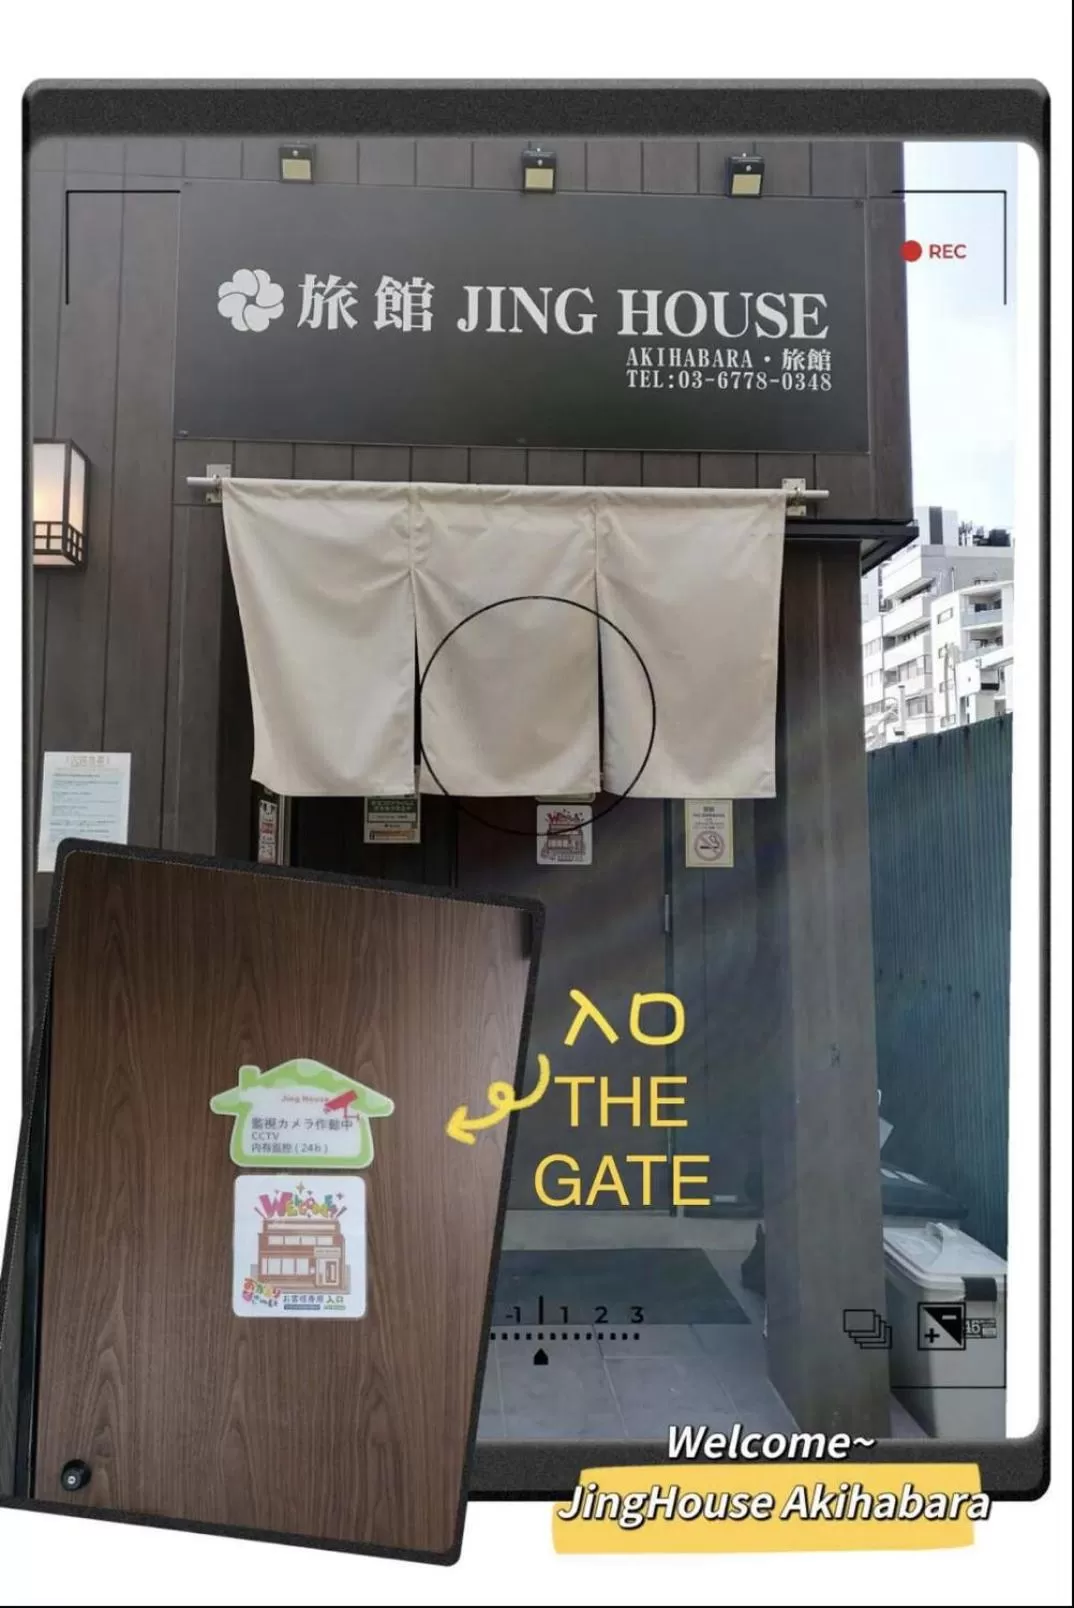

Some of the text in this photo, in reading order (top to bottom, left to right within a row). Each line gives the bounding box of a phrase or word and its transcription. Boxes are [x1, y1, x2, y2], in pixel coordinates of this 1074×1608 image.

[457, 285, 597, 335] JING
[617, 288, 829, 339] HOUSE
[626, 369, 832, 391] TEL:03-6778-0348
[251, 1131, 280, 1141] CCTV
